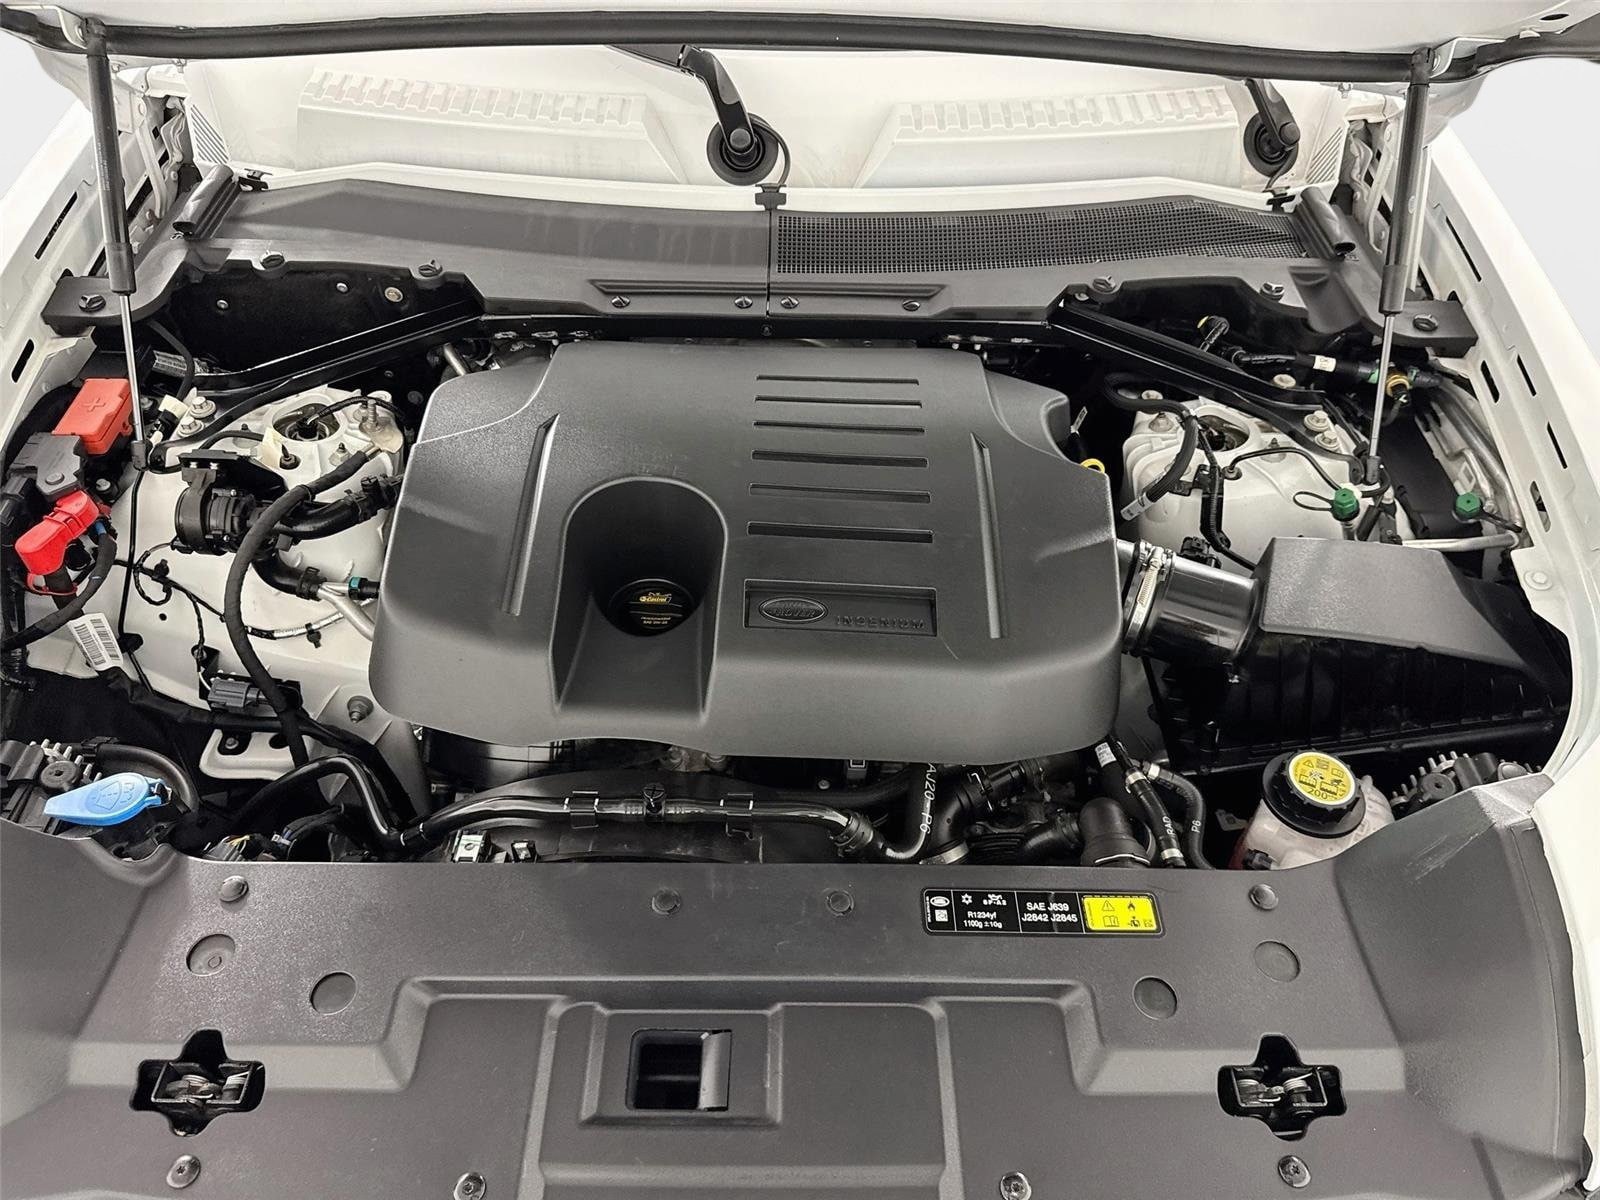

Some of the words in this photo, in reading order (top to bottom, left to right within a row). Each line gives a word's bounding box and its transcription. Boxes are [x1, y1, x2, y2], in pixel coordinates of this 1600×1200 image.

[837, 615, 925, 630] INGENIUM
[1162, 816, 1176, 835] RAD
[1191, 819, 1202, 833] P6
[1026, 902, 1046, 911] SAE
[1047, 902, 1070, 912] J639
[967, 910, 997, 920] R1234yf
[1021, 912, 1049, 922] J2842
[1050, 913, 1078, 923] J2845
[963, 919, 983, 929] 1100g
[984, 921, 1003, 929] ±10g
